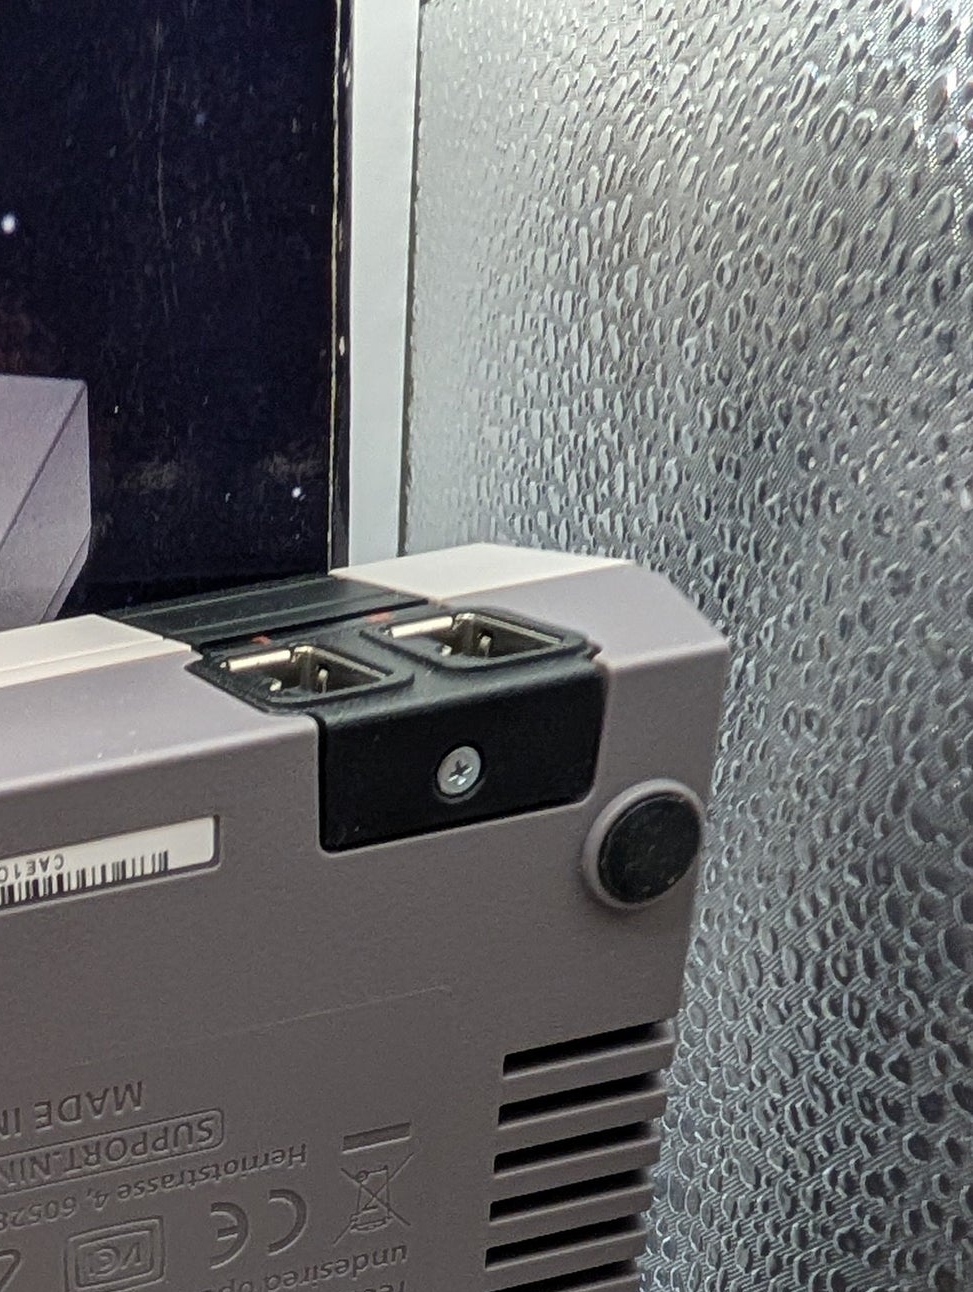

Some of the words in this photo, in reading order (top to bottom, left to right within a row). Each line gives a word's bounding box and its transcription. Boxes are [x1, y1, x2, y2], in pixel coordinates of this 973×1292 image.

[35, 1077, 141, 1131] MADE
[87, 1183, 108, 1212] 4,
[118, 1140, 307, 1206] Herriotstrasse
